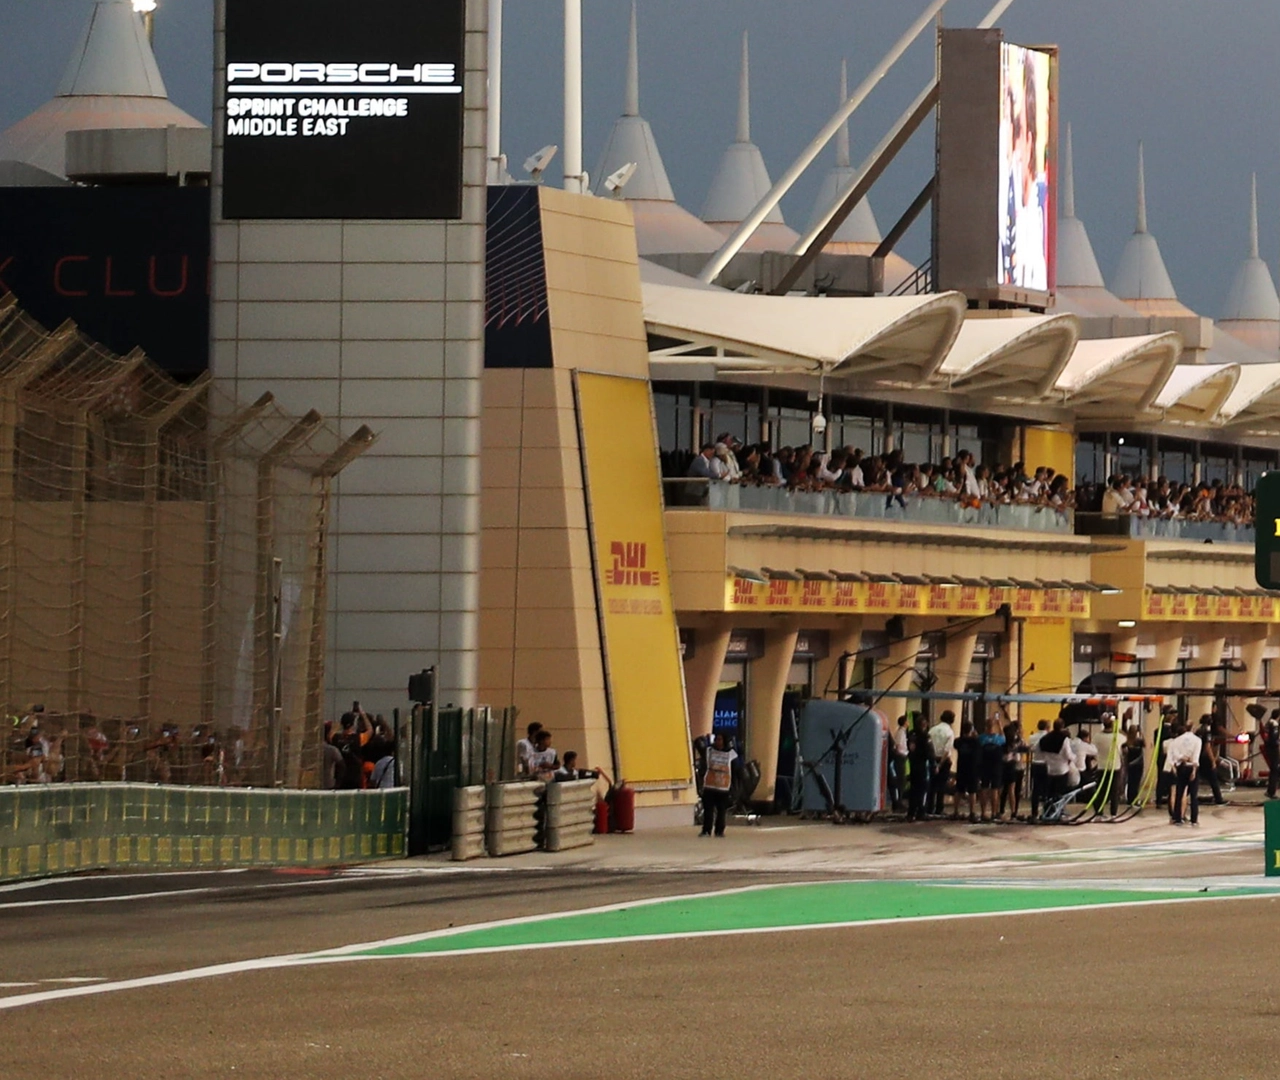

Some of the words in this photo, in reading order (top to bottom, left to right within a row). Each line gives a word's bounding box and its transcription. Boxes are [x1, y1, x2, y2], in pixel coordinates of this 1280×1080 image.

[227, 63, 455, 83] PORSCHE
[226, 98, 296, 117] SPRINT
[298, 98, 408, 117] CHALLENGE
[227, 118, 298, 136] MIDDLE
[302, 118, 349, 136] EAST
[54, 255, 211, 297] CLU
[606, 540, 659, 587] DHL
